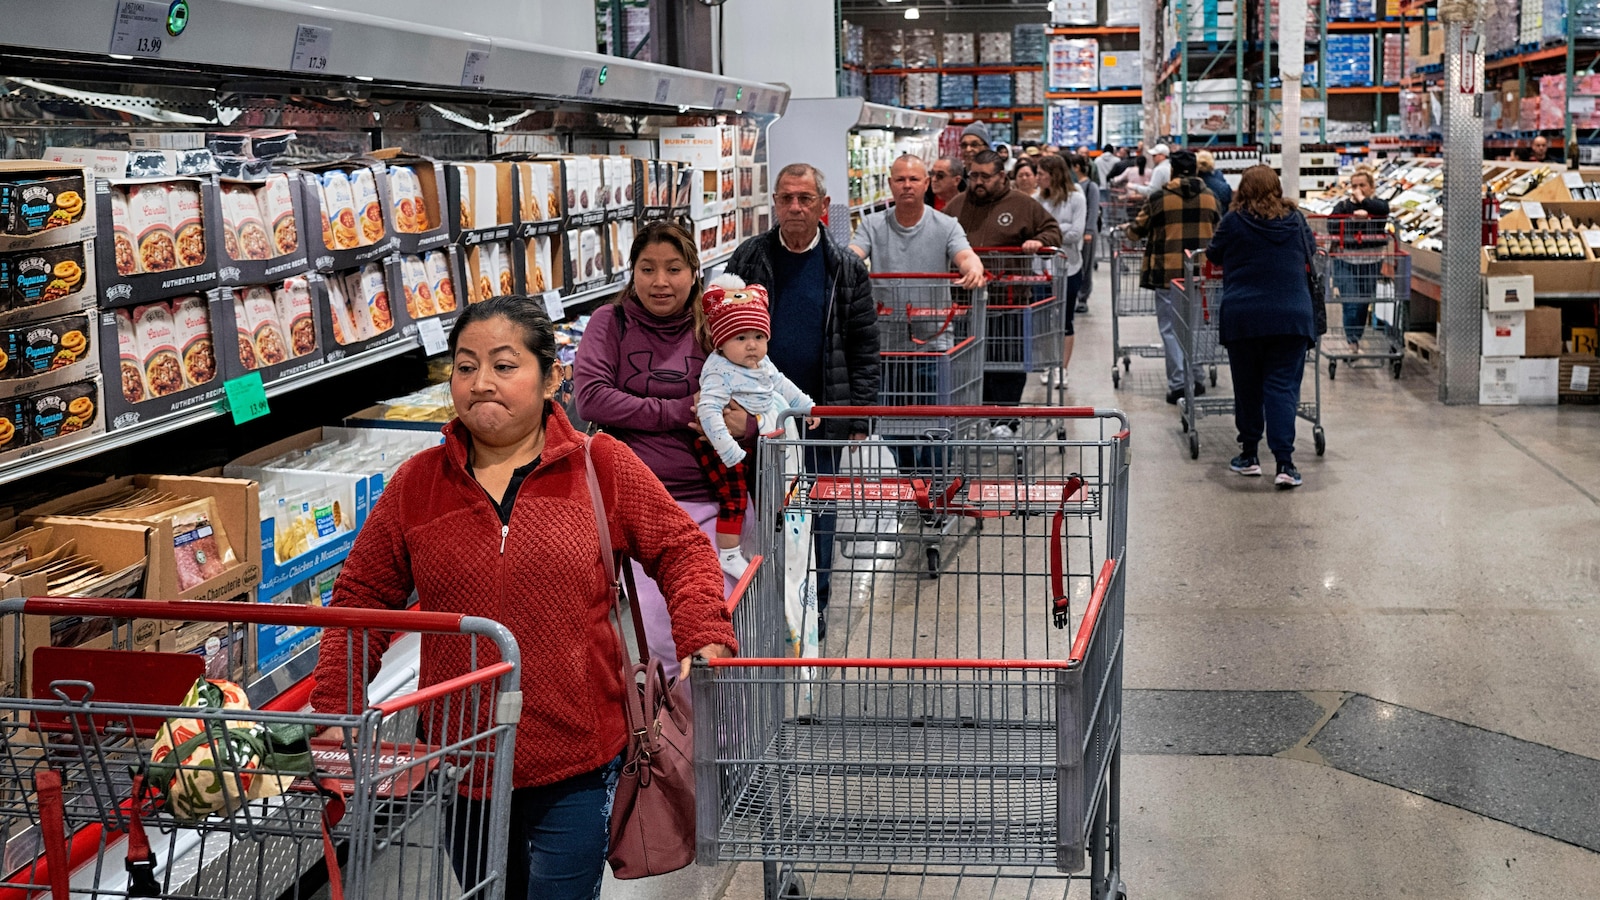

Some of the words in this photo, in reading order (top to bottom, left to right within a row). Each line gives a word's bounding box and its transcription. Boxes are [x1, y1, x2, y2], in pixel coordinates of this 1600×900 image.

[136, 37, 162, 53] 13.99
[308, 56, 327, 70] 17.39
[21, 203, 50, 216] Pupusas
[265, 262, 291, 275] AUTHENTIC
[291, 257, 308, 268] RECIPE
[161, 275, 195, 289] AUTHENTIC
[195, 272, 217, 283] RECIPE
[25, 345, 55, 359] Pupusas
[280, 363, 307, 378] AUTHENTIC
[307, 357, 324, 369] RECIPE
[171, 393, 205, 411] AUTHENTIC
[205, 387, 225, 399] RECIPE
[249, 400, 267, 416] 13.99
[35, 412, 63, 427] Pupusas
[288, 559, 314, 578] Chicken
[314, 554, 320, 565] &
[320, 540, 351, 562] Mozzarella
[207, 576, 241, 601] Charcuterie
